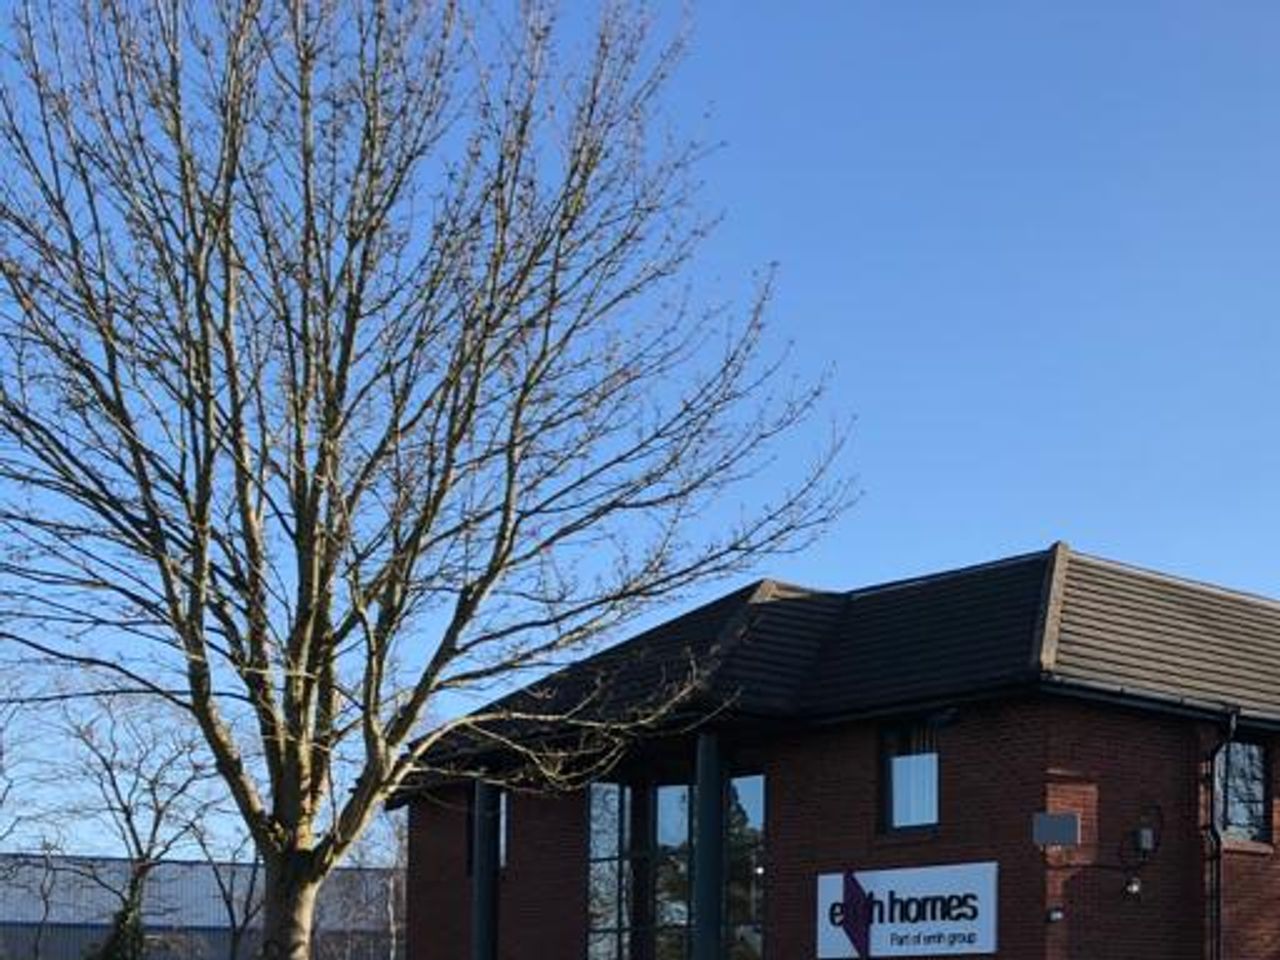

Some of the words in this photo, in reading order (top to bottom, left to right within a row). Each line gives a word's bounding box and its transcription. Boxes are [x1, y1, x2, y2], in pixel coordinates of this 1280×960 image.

[829, 891, 883, 926] eh
[888, 890, 978, 925] homes
[890, 933, 908, 946] Part
[910, 933, 921, 944] of
[947, 932, 977, 947] group
